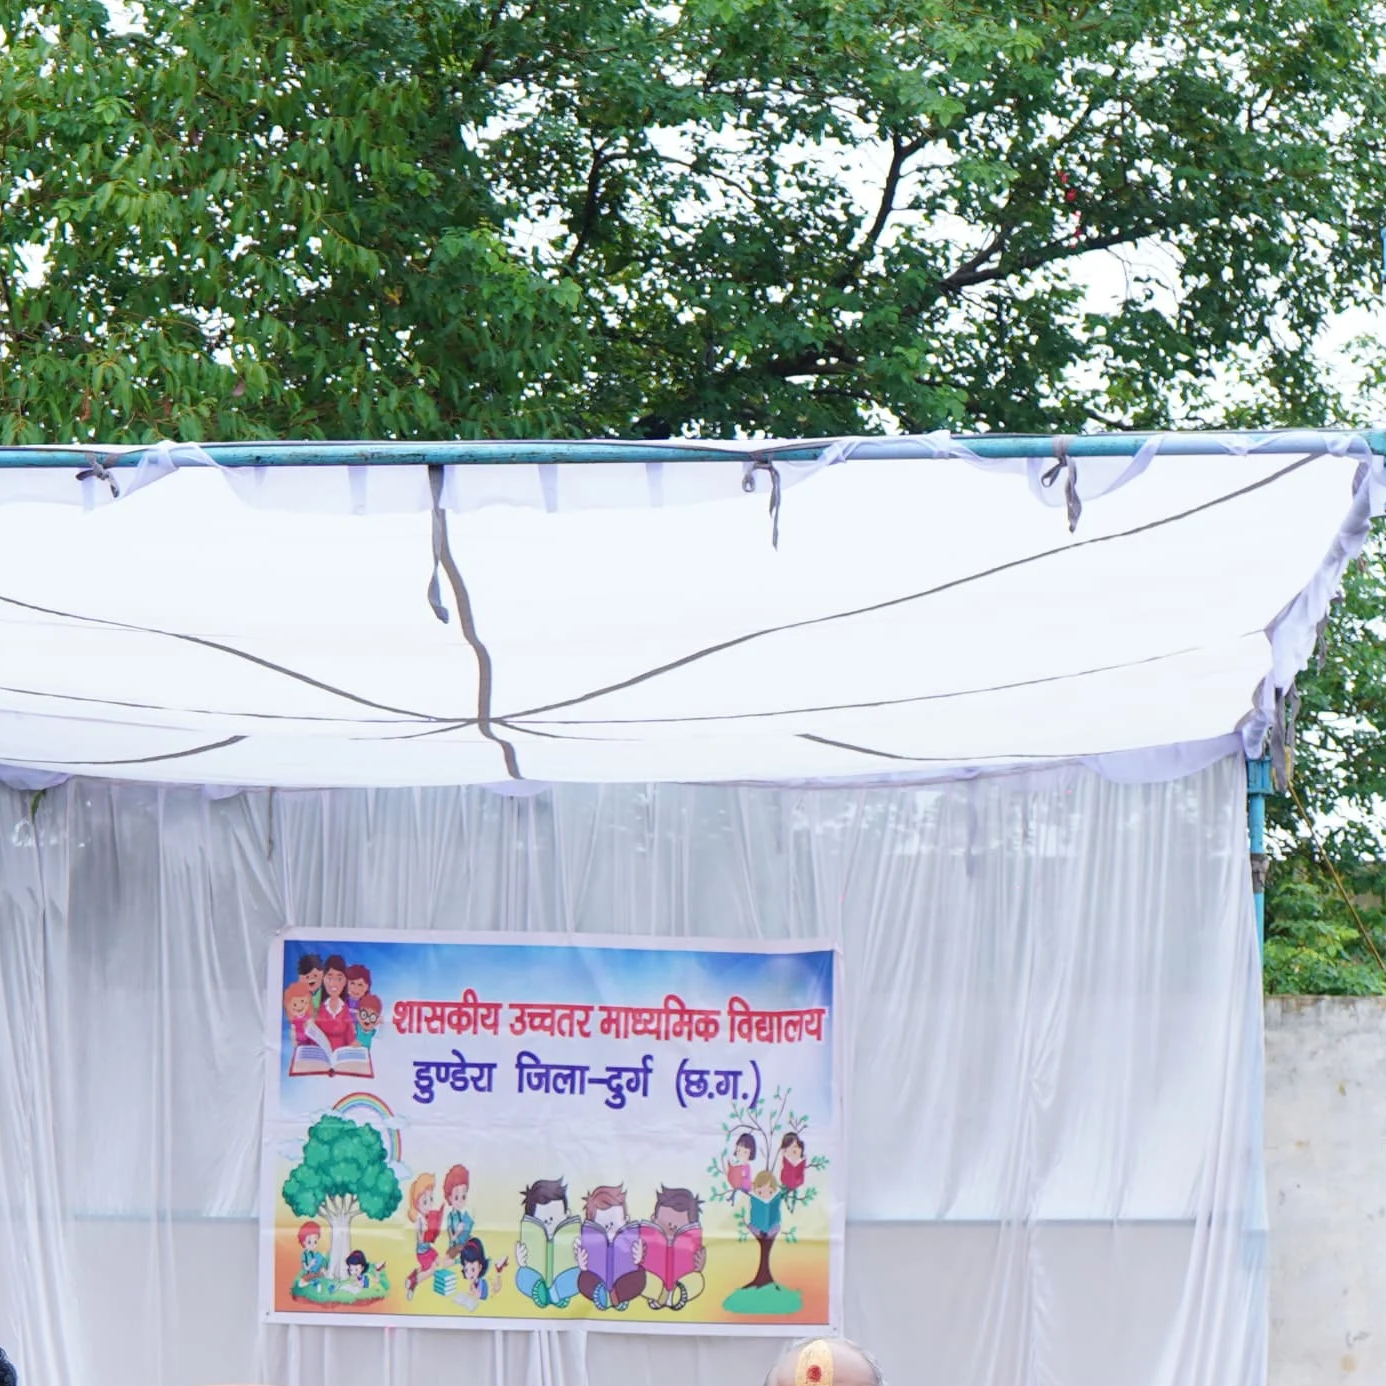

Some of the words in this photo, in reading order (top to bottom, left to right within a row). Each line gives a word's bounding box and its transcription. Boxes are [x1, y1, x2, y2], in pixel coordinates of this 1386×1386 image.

[393, 988, 502, 1035] शासकीय
[509, 1003, 593, 1038] उच्चतर
[599, 994, 721, 1042] माध्यमिक
[727, 996, 827, 1043] विद्यालय
[412, 1048, 497, 1104] डुण्डेरा
[675, 1058, 762, 1110] (छ.ग.)
